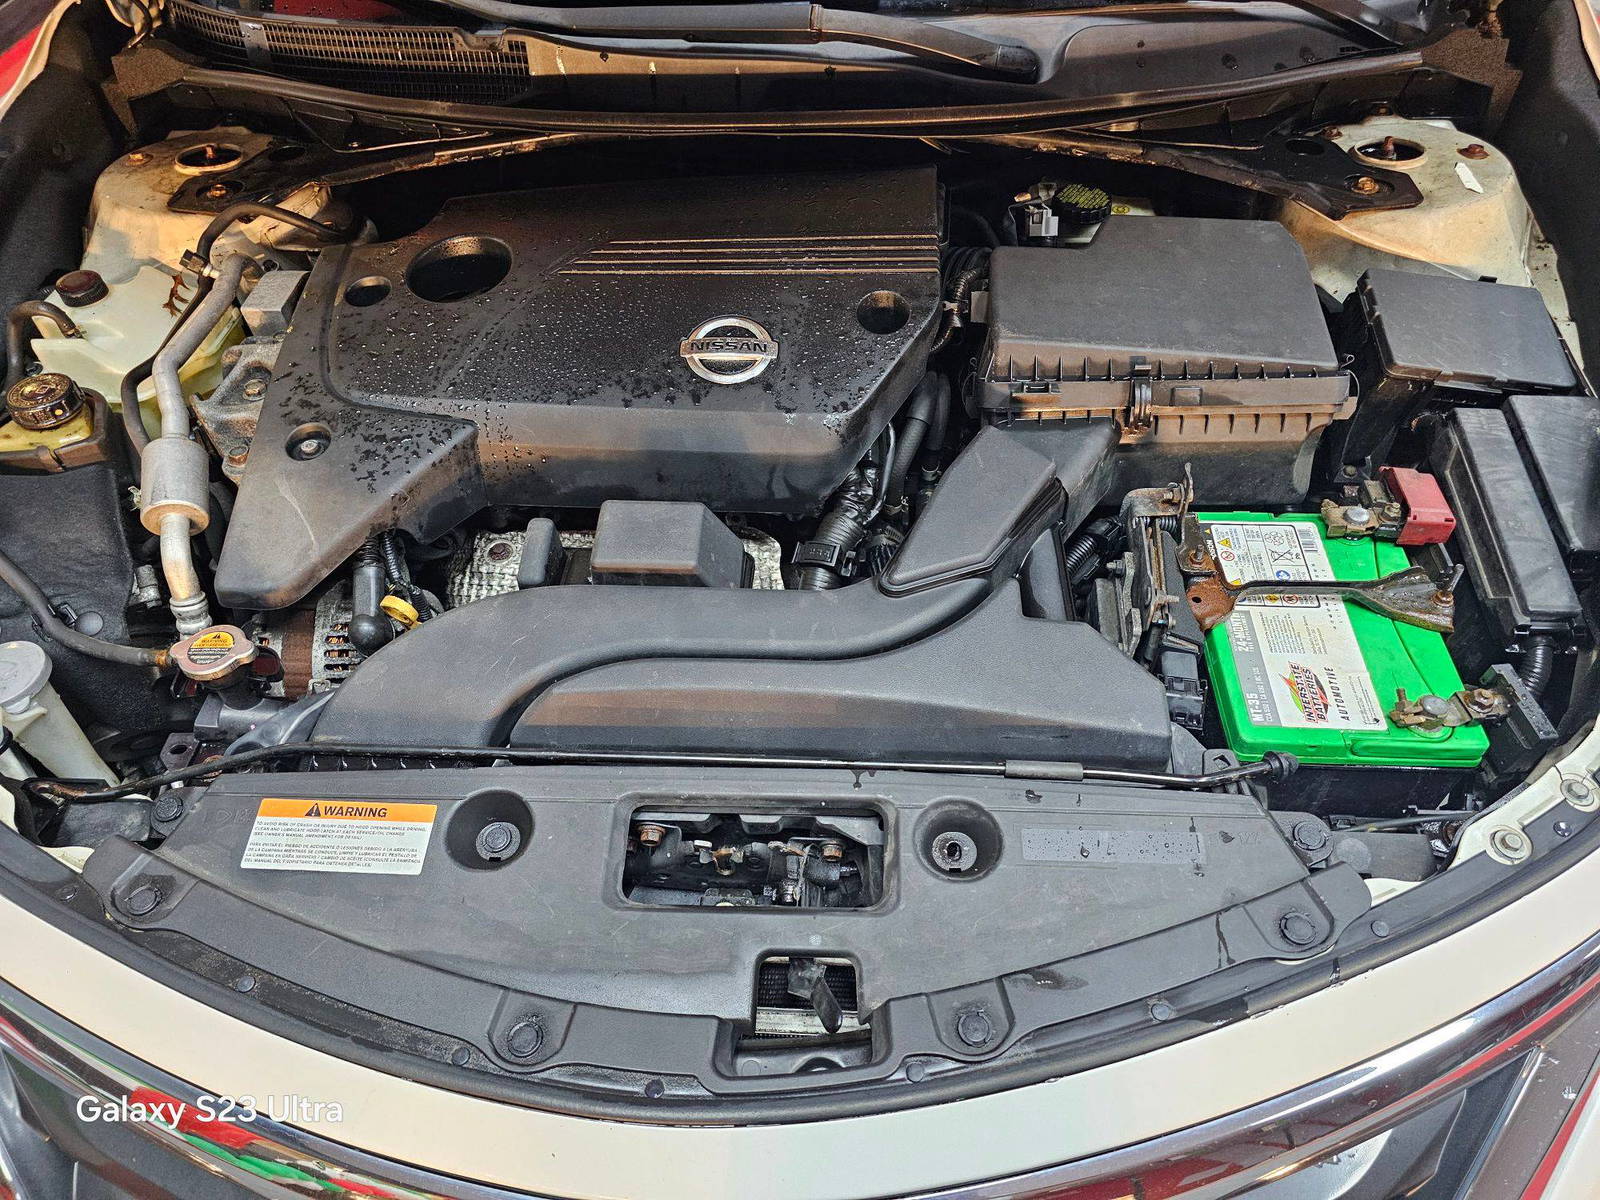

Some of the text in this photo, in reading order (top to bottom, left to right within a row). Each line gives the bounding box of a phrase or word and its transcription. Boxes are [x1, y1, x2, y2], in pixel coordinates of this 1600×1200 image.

[690, 341, 767, 352] NISSAN
[1246, 693, 1264, 721] MT-35
[1290, 664, 1314, 722] INTERSTATE
[1302, 668, 1326, 720] BATTERIES
[1324, 666, 1350, 721] AUTOMOTIVE
[324, 806, 387, 817] WARNING
